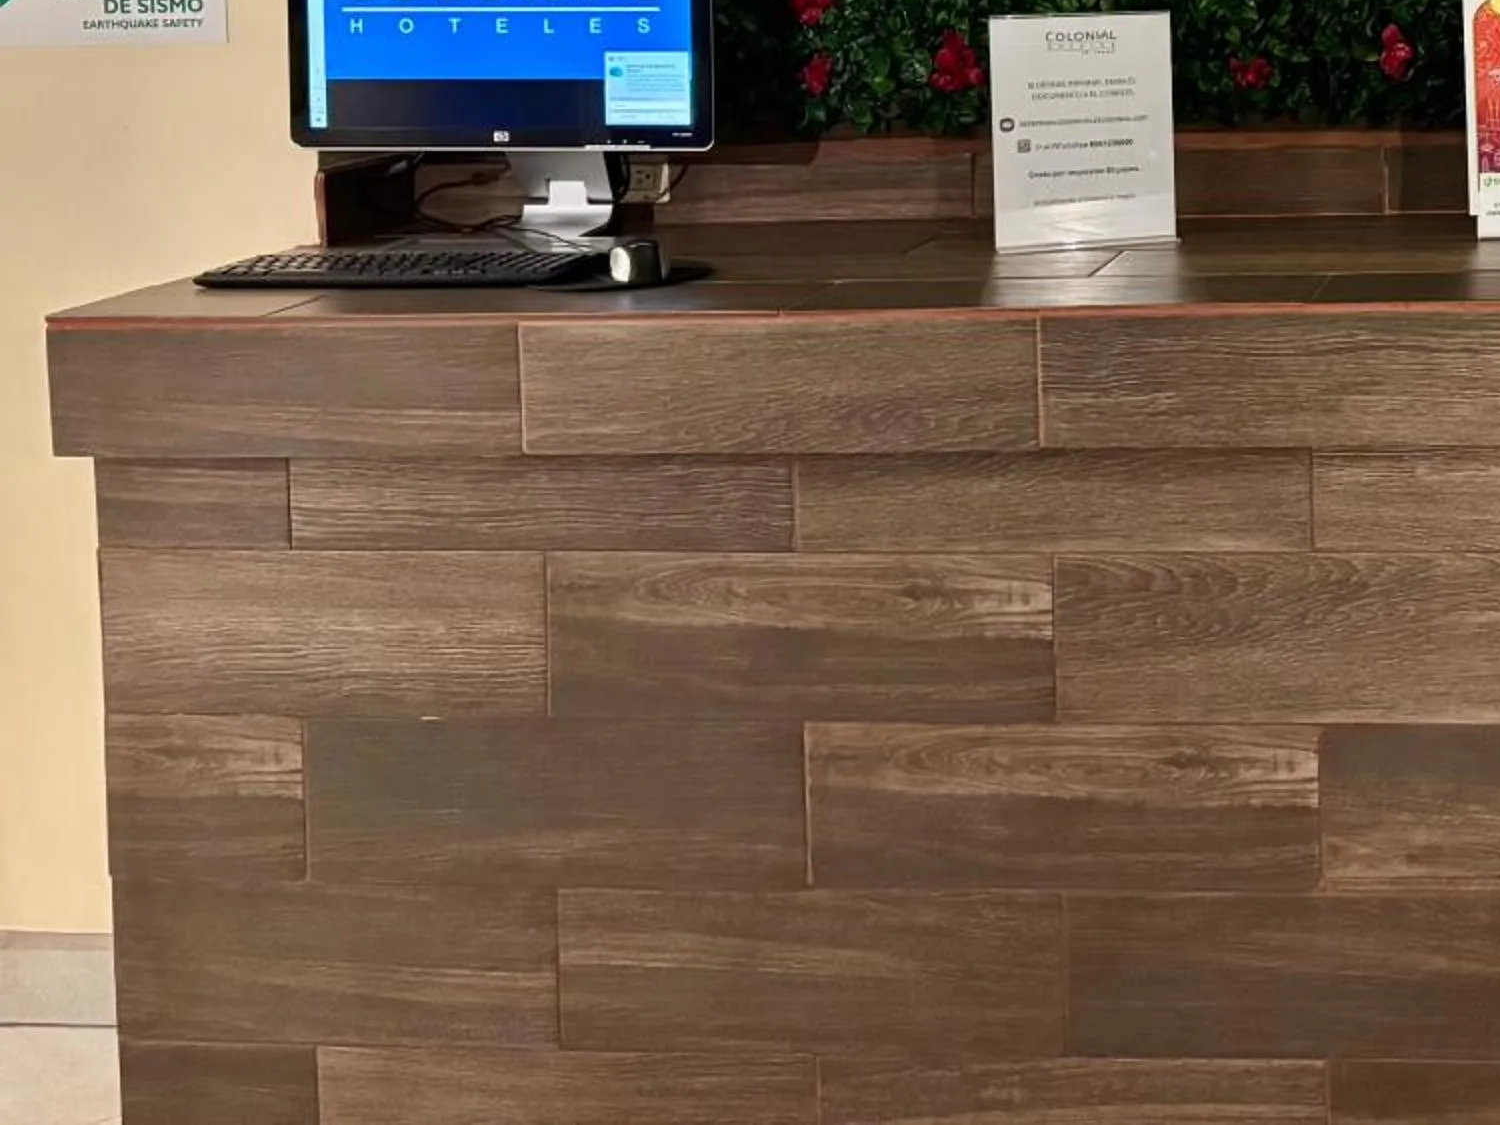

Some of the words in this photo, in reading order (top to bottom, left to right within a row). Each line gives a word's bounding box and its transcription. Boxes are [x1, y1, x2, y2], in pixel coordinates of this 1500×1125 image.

[83, 19, 159, 30] EARTHQUAKE
[162, 18, 203, 28] SAFETY
[349, 17, 651, 34] HOTELES
[1045, 29, 1117, 42] COLONIAL
